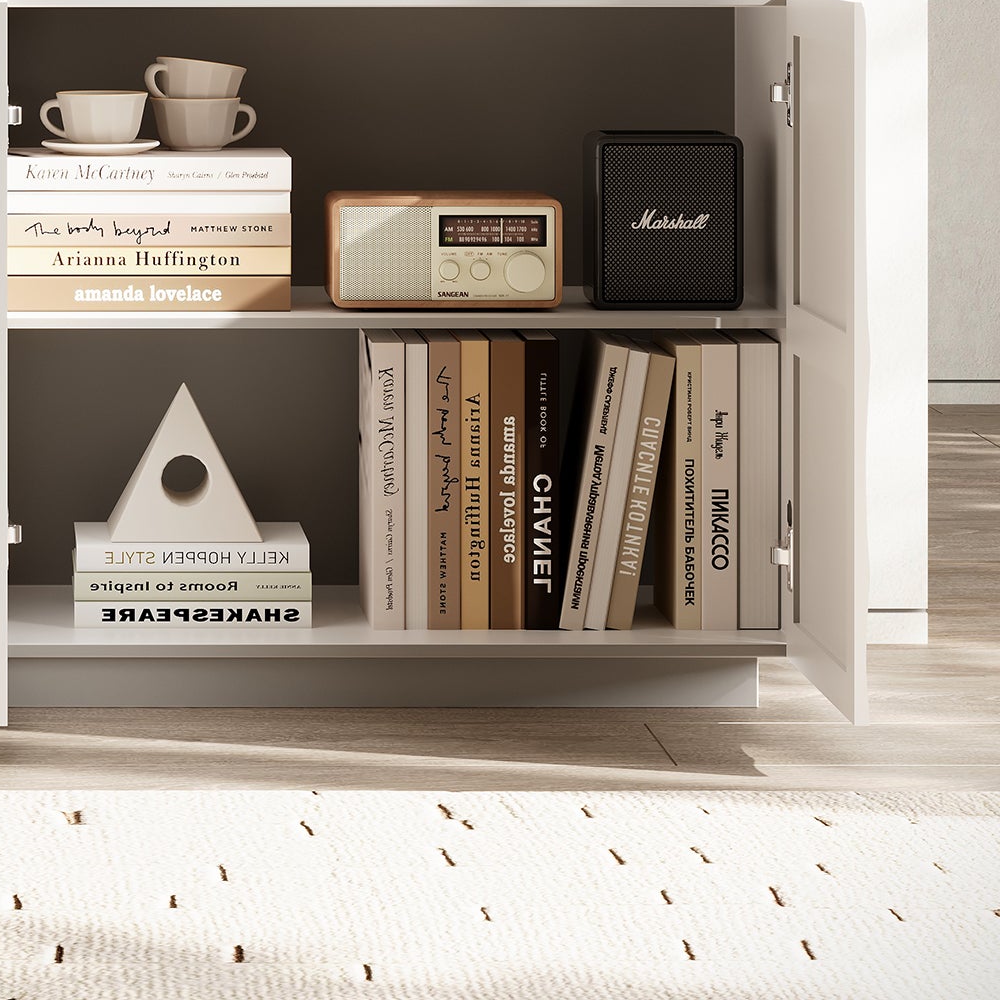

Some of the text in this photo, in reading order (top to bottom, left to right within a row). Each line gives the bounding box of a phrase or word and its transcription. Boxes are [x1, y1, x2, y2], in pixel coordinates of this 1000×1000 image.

[25, 164, 155, 185] Karen McCartney
[25, 222, 60, 236] The
[632, 208, 710, 230] Marshall
[52, 251, 240, 271] Arianna Huffington
[74, 285, 222, 302] amanda lovelace
[684, 459, 694, 606] ПОХИТИТЕЛЬ БАБОЧЕК
[712, 489, 729, 570] ПИКАССО
